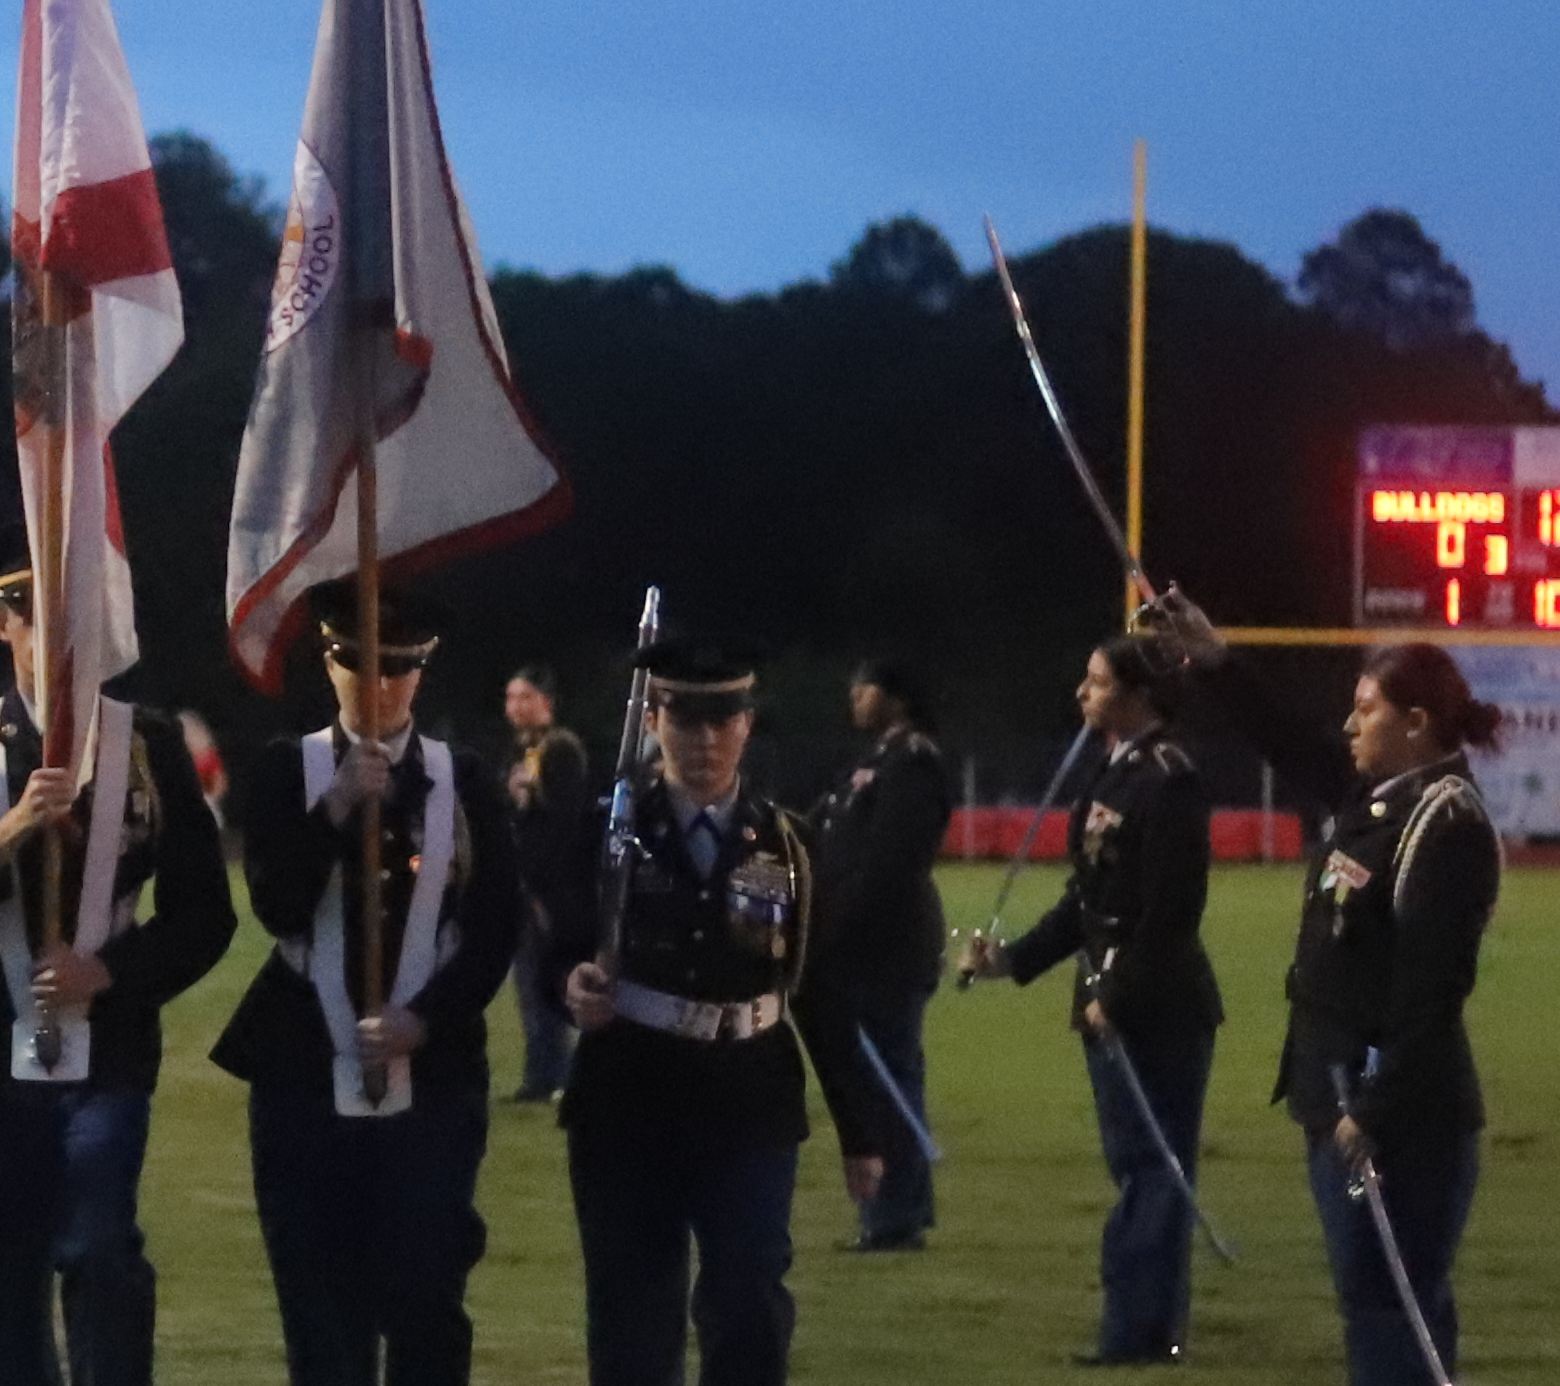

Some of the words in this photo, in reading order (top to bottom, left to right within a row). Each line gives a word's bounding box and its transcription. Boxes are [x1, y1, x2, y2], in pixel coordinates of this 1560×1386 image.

[281, 214, 334, 327] SCHOOL
[1373, 490, 1505, 523] BULLDOGS
[1437, 520, 1465, 568] 0
[1446, 578, 1460, 626] 1
